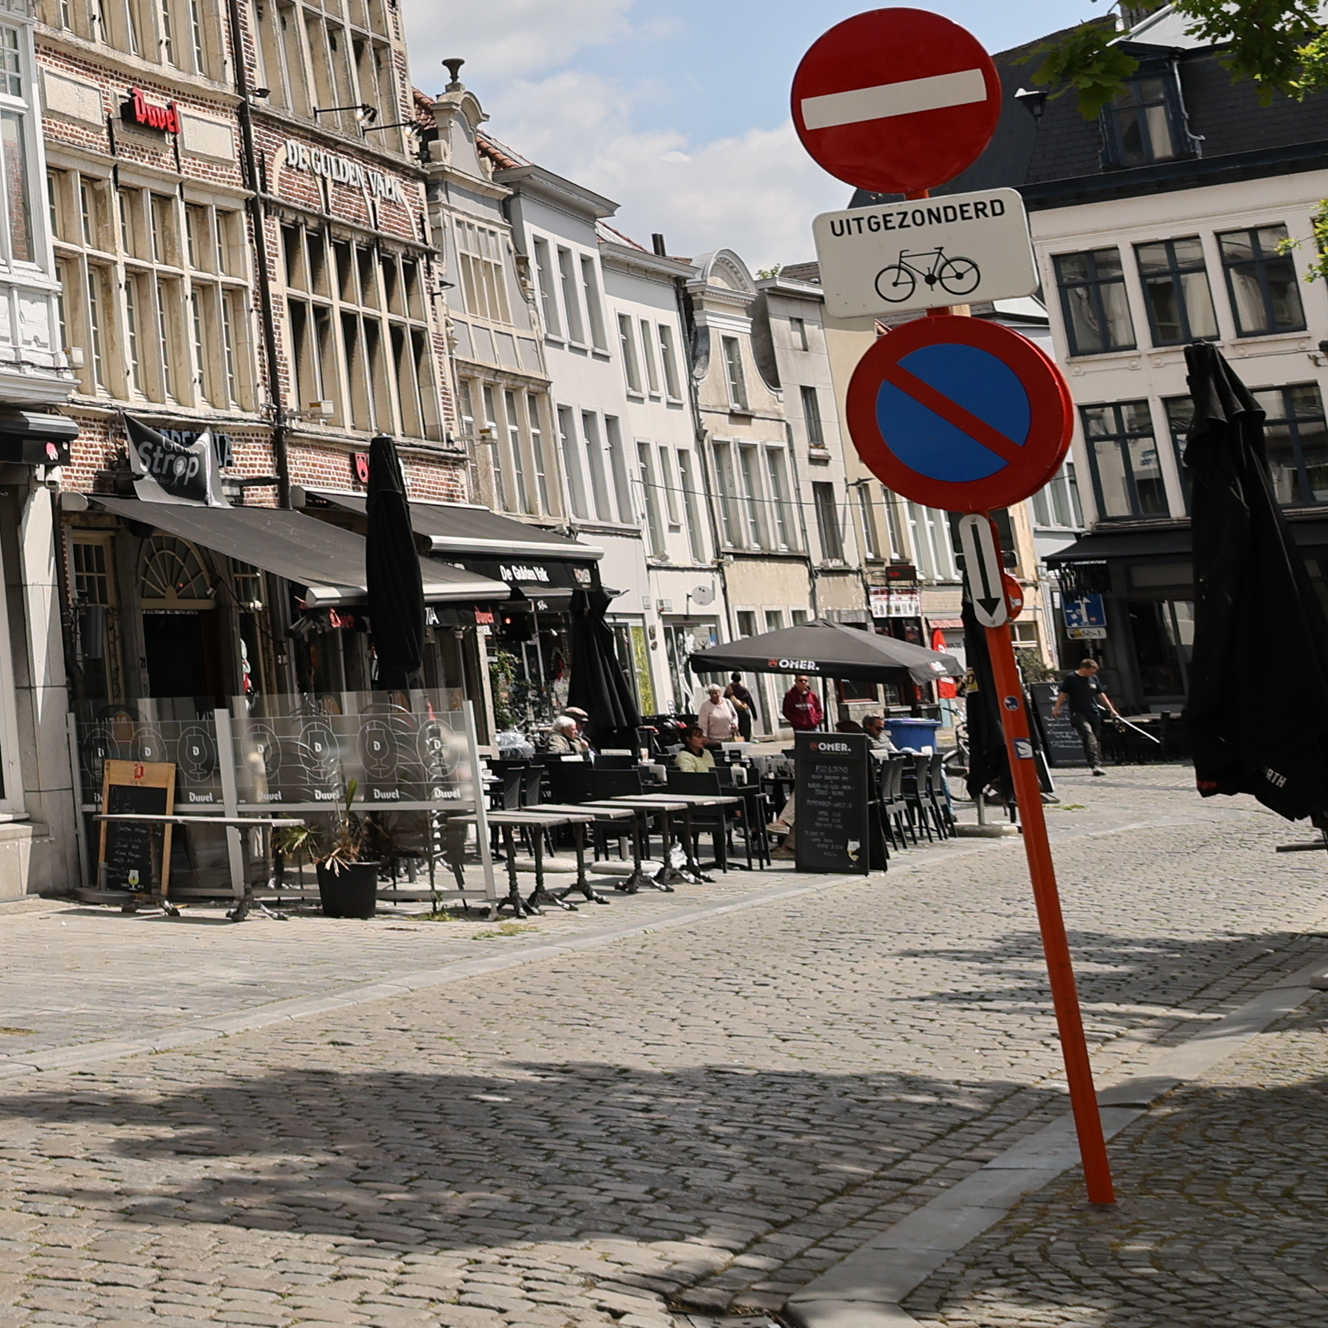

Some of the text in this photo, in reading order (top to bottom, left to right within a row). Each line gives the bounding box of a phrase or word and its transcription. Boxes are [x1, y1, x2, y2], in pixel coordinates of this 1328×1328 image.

[132, 87, 181, 135] Duvel
[286, 139, 405, 203] DE GULDEN VALK
[830, 198, 1005, 237] UITGEZONDERD
[139, 441, 200, 486] Strop
[499, 565, 513, 581] De
[188, 791, 214, 803] Duvel
[314, 789, 341, 801] Duvel
[373, 788, 400, 800] Duvel
[434, 787, 462, 800] Duvel
